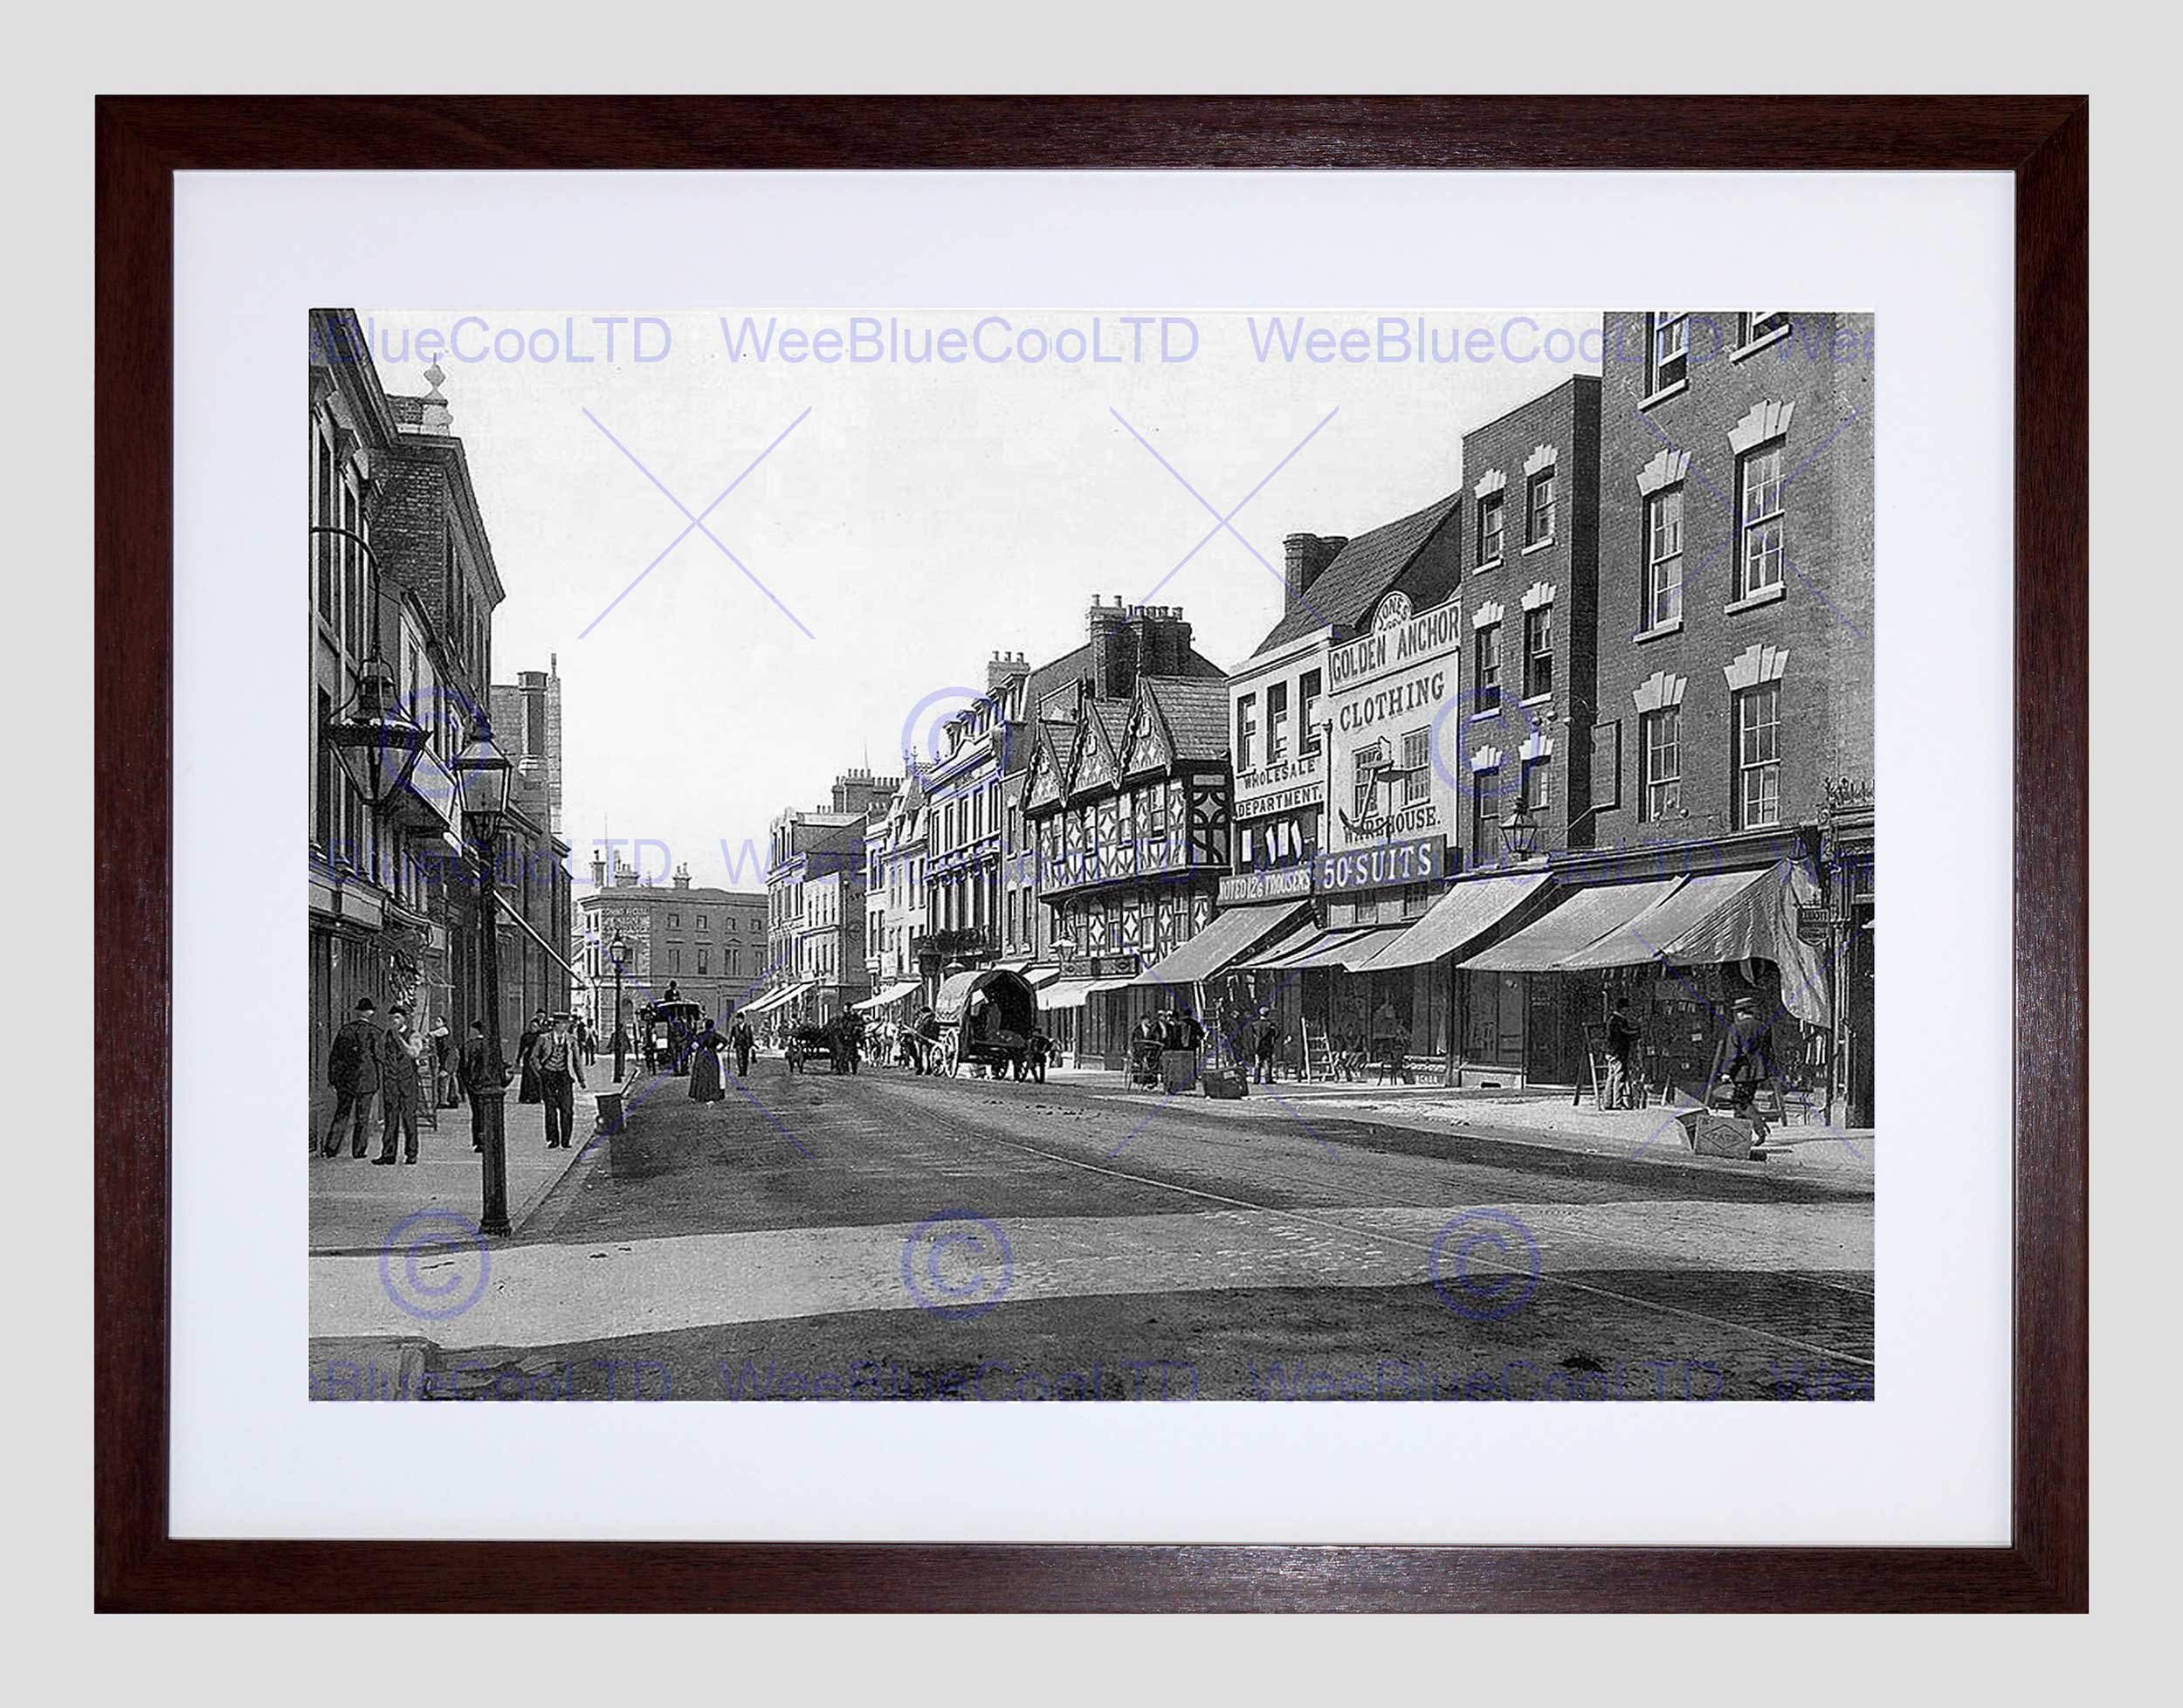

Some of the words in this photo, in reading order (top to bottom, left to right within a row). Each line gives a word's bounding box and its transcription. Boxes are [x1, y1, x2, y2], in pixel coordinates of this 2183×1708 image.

[1332, 634, 1387, 681] GOLDEN
[1397, 605, 1460, 661] ANCHOR
[1340, 671, 1445, 732] CLOTHING
[1244, 760, 1315, 789] WHOLESALE
[1355, 843, 1431, 885] SUITS
